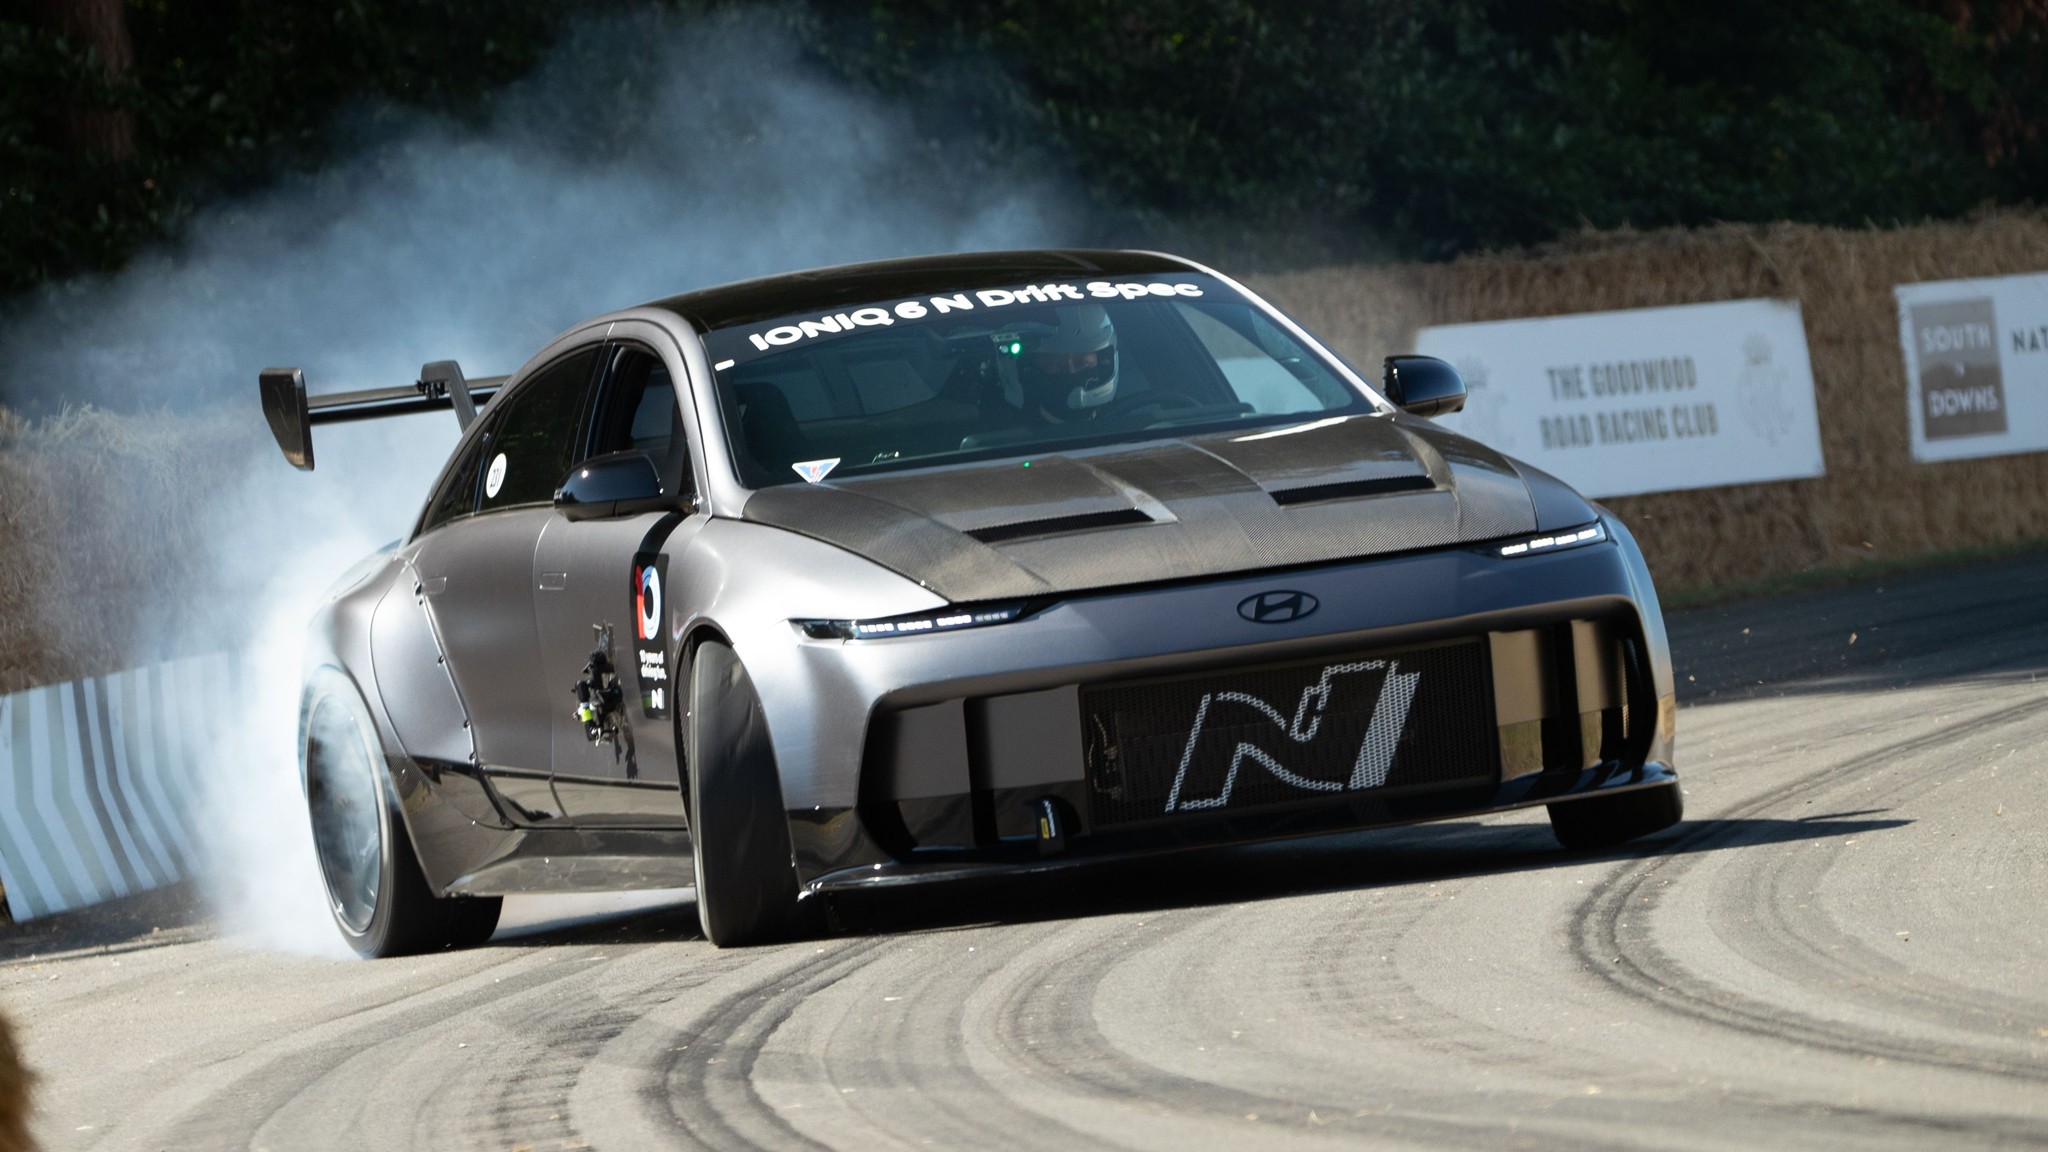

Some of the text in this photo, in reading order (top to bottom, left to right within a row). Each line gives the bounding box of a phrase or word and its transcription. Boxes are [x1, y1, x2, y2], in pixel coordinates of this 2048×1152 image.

[749, 281, 1204, 352] IONIQ 6 N Drift Spec
[1921, 323, 1991, 353] SOUTH
[1546, 355, 1697, 400] THE GOODWOOD
[1928, 384, 1999, 417] DOWNS
[1540, 402, 1719, 451] ROAD RACING CLUB
[651, 687, 665, 710] N
